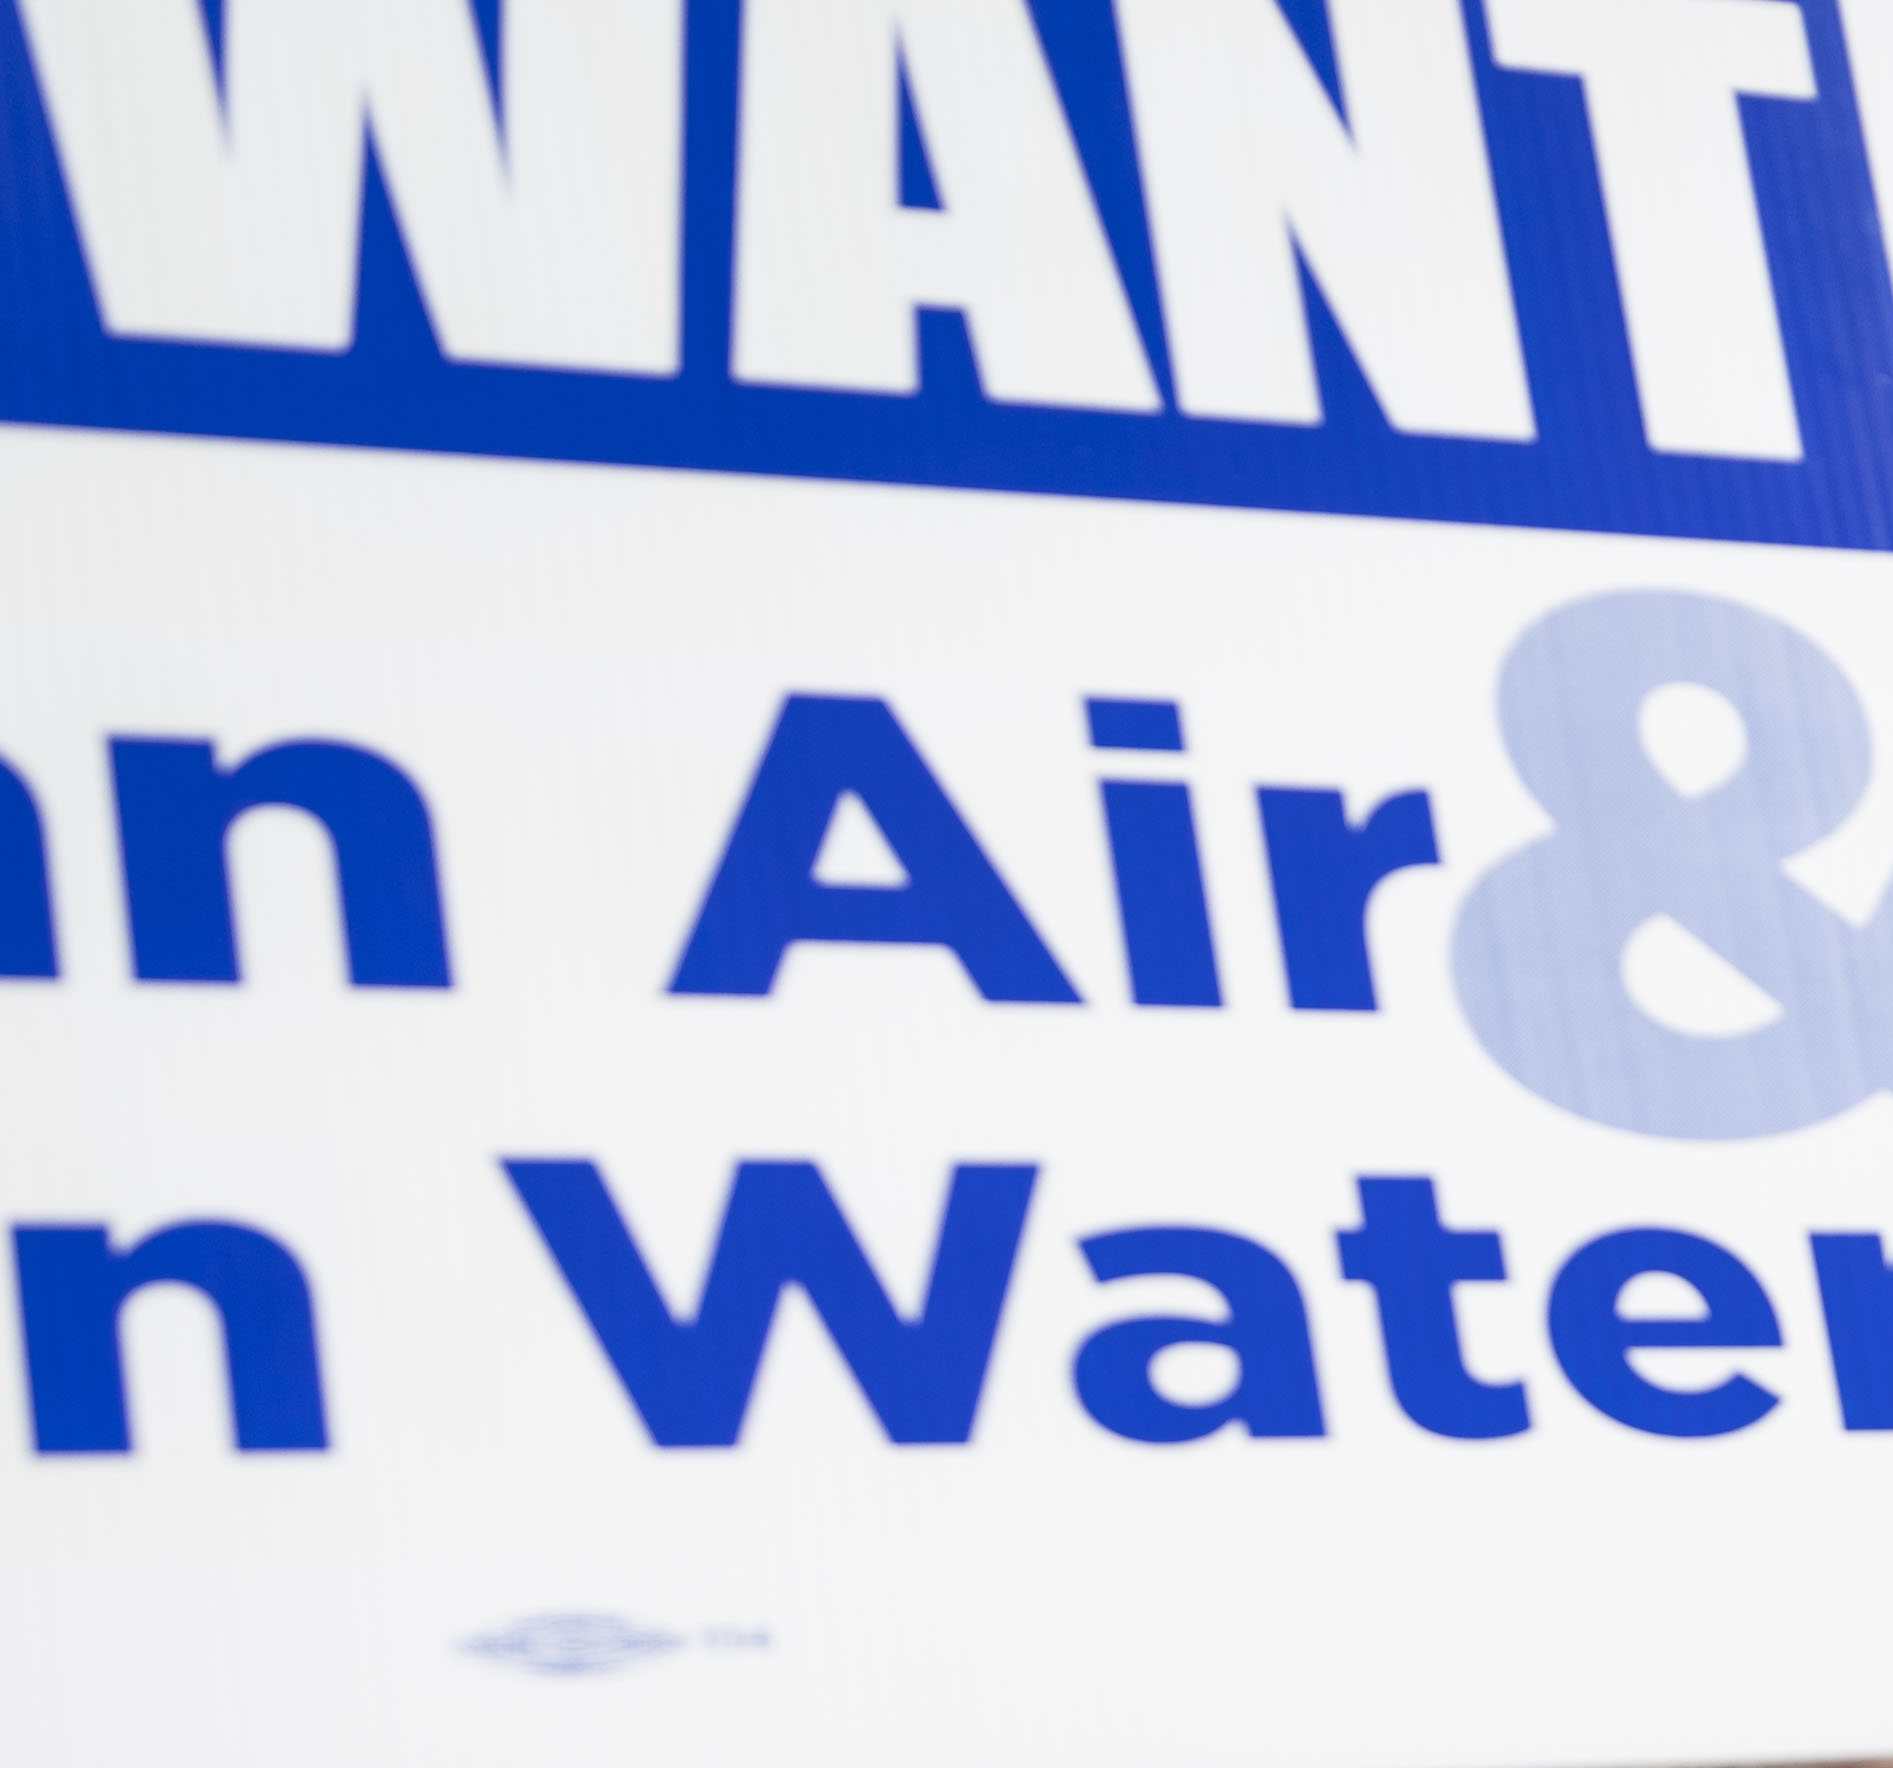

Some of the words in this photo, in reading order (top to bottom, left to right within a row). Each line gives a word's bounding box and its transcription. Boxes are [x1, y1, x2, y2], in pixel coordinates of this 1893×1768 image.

[18, 0, 1820, 462] WANT
[0, 733, 455, 992] n
[664, 690, 1442, 1013] Air
